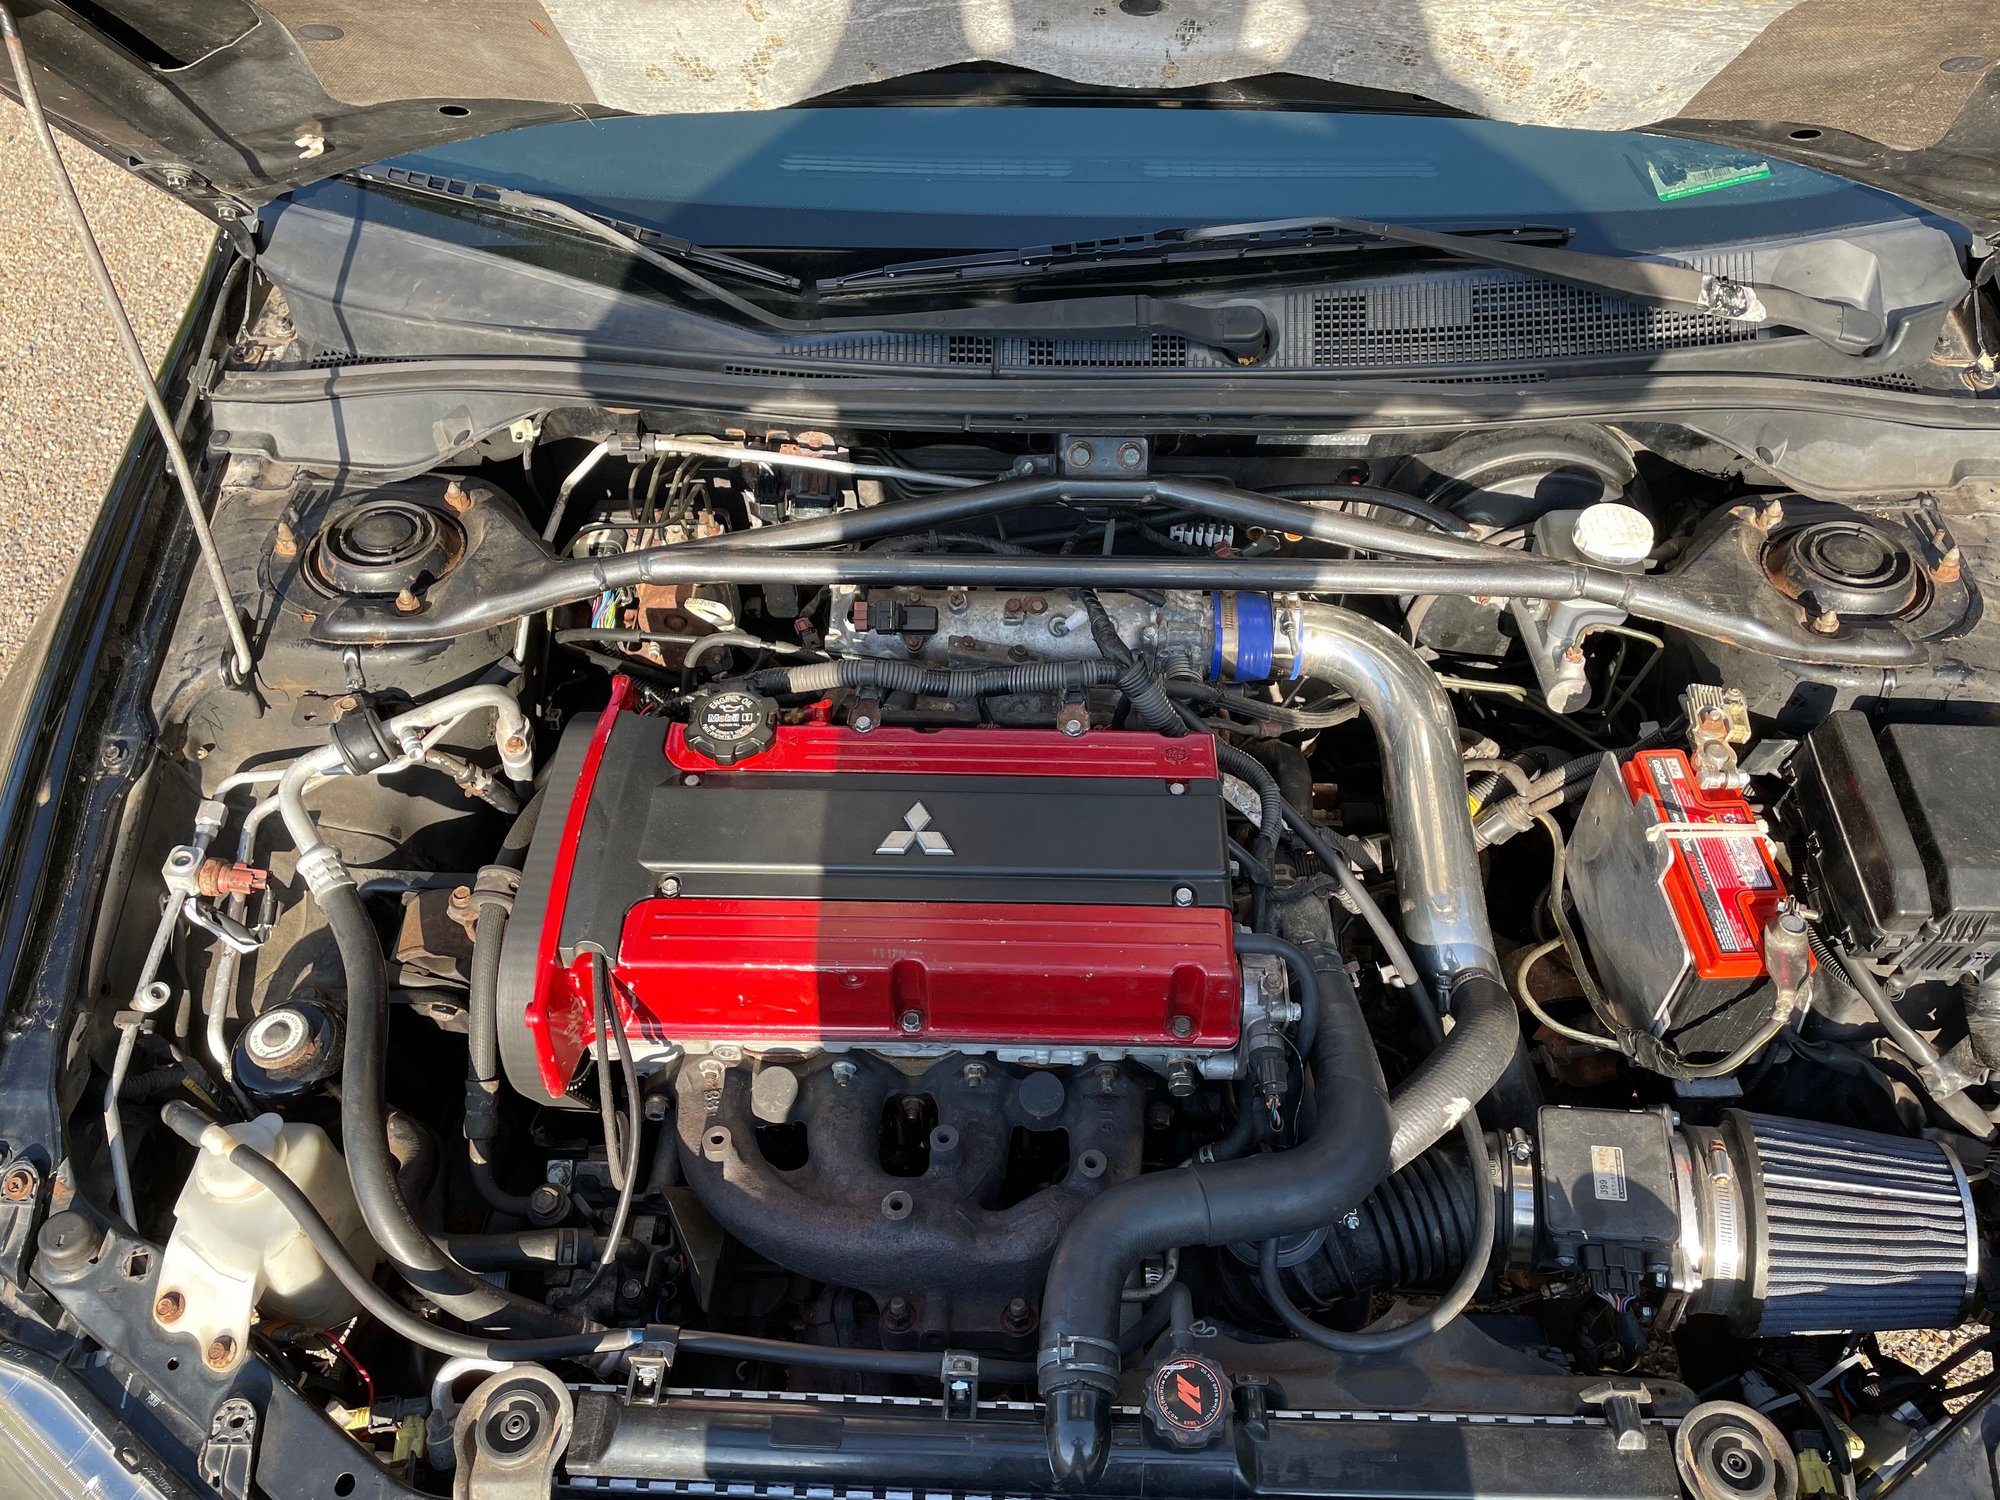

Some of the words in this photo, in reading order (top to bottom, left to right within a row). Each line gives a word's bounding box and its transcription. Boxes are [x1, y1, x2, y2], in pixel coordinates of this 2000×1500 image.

[708, 695, 741, 709] ENGINE
[741, 698, 753, 708] OIL
[707, 714, 739, 722] Mobil
[1652, 759, 1668, 784] PC680
[1599, 1179, 1608, 1195] 399
